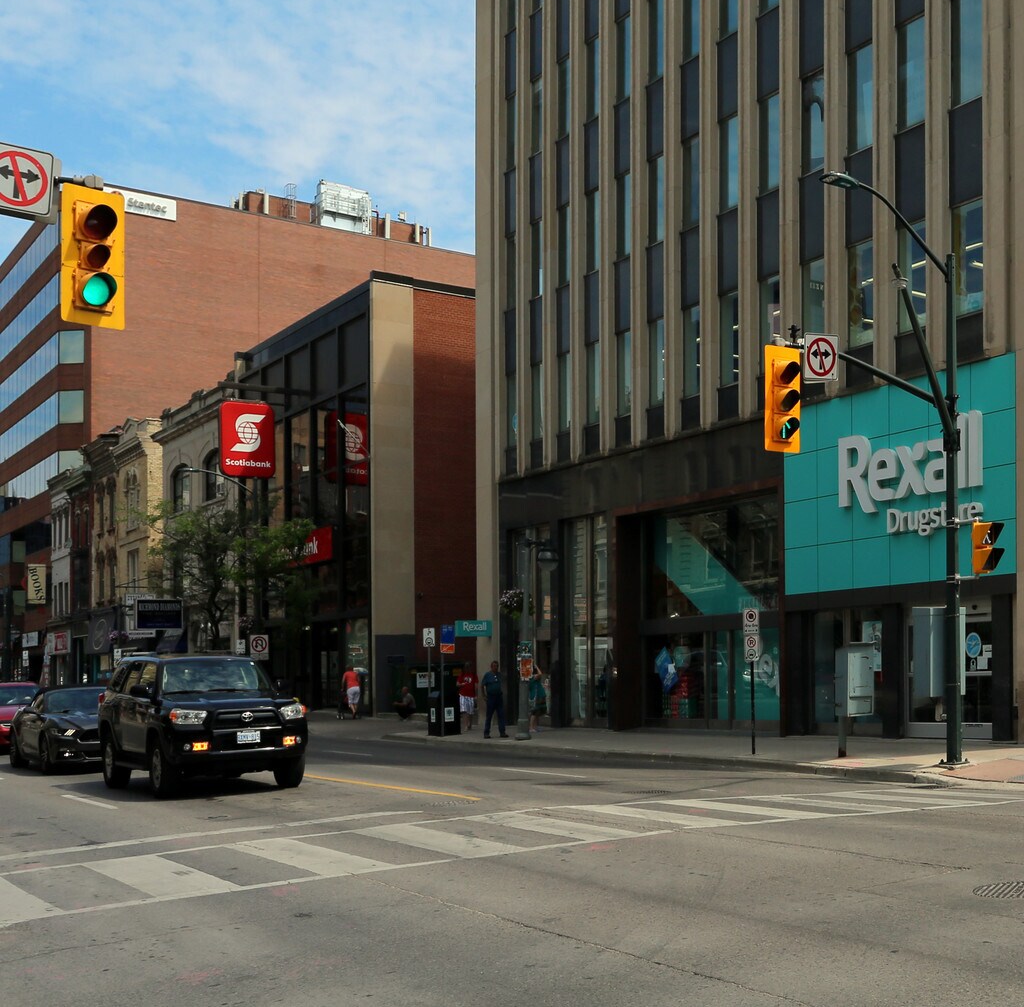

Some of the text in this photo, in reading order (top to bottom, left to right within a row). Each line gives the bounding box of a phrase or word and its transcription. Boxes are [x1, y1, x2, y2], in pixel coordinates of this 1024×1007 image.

[226, 458, 271, 468] Scotiabank
[838, 410, 984, 513] Rexall
[886, 501, 984, 536] Drugstre
[28, 568, 45, 601] BOOKS
[463, 622, 486, 631] Rexall
